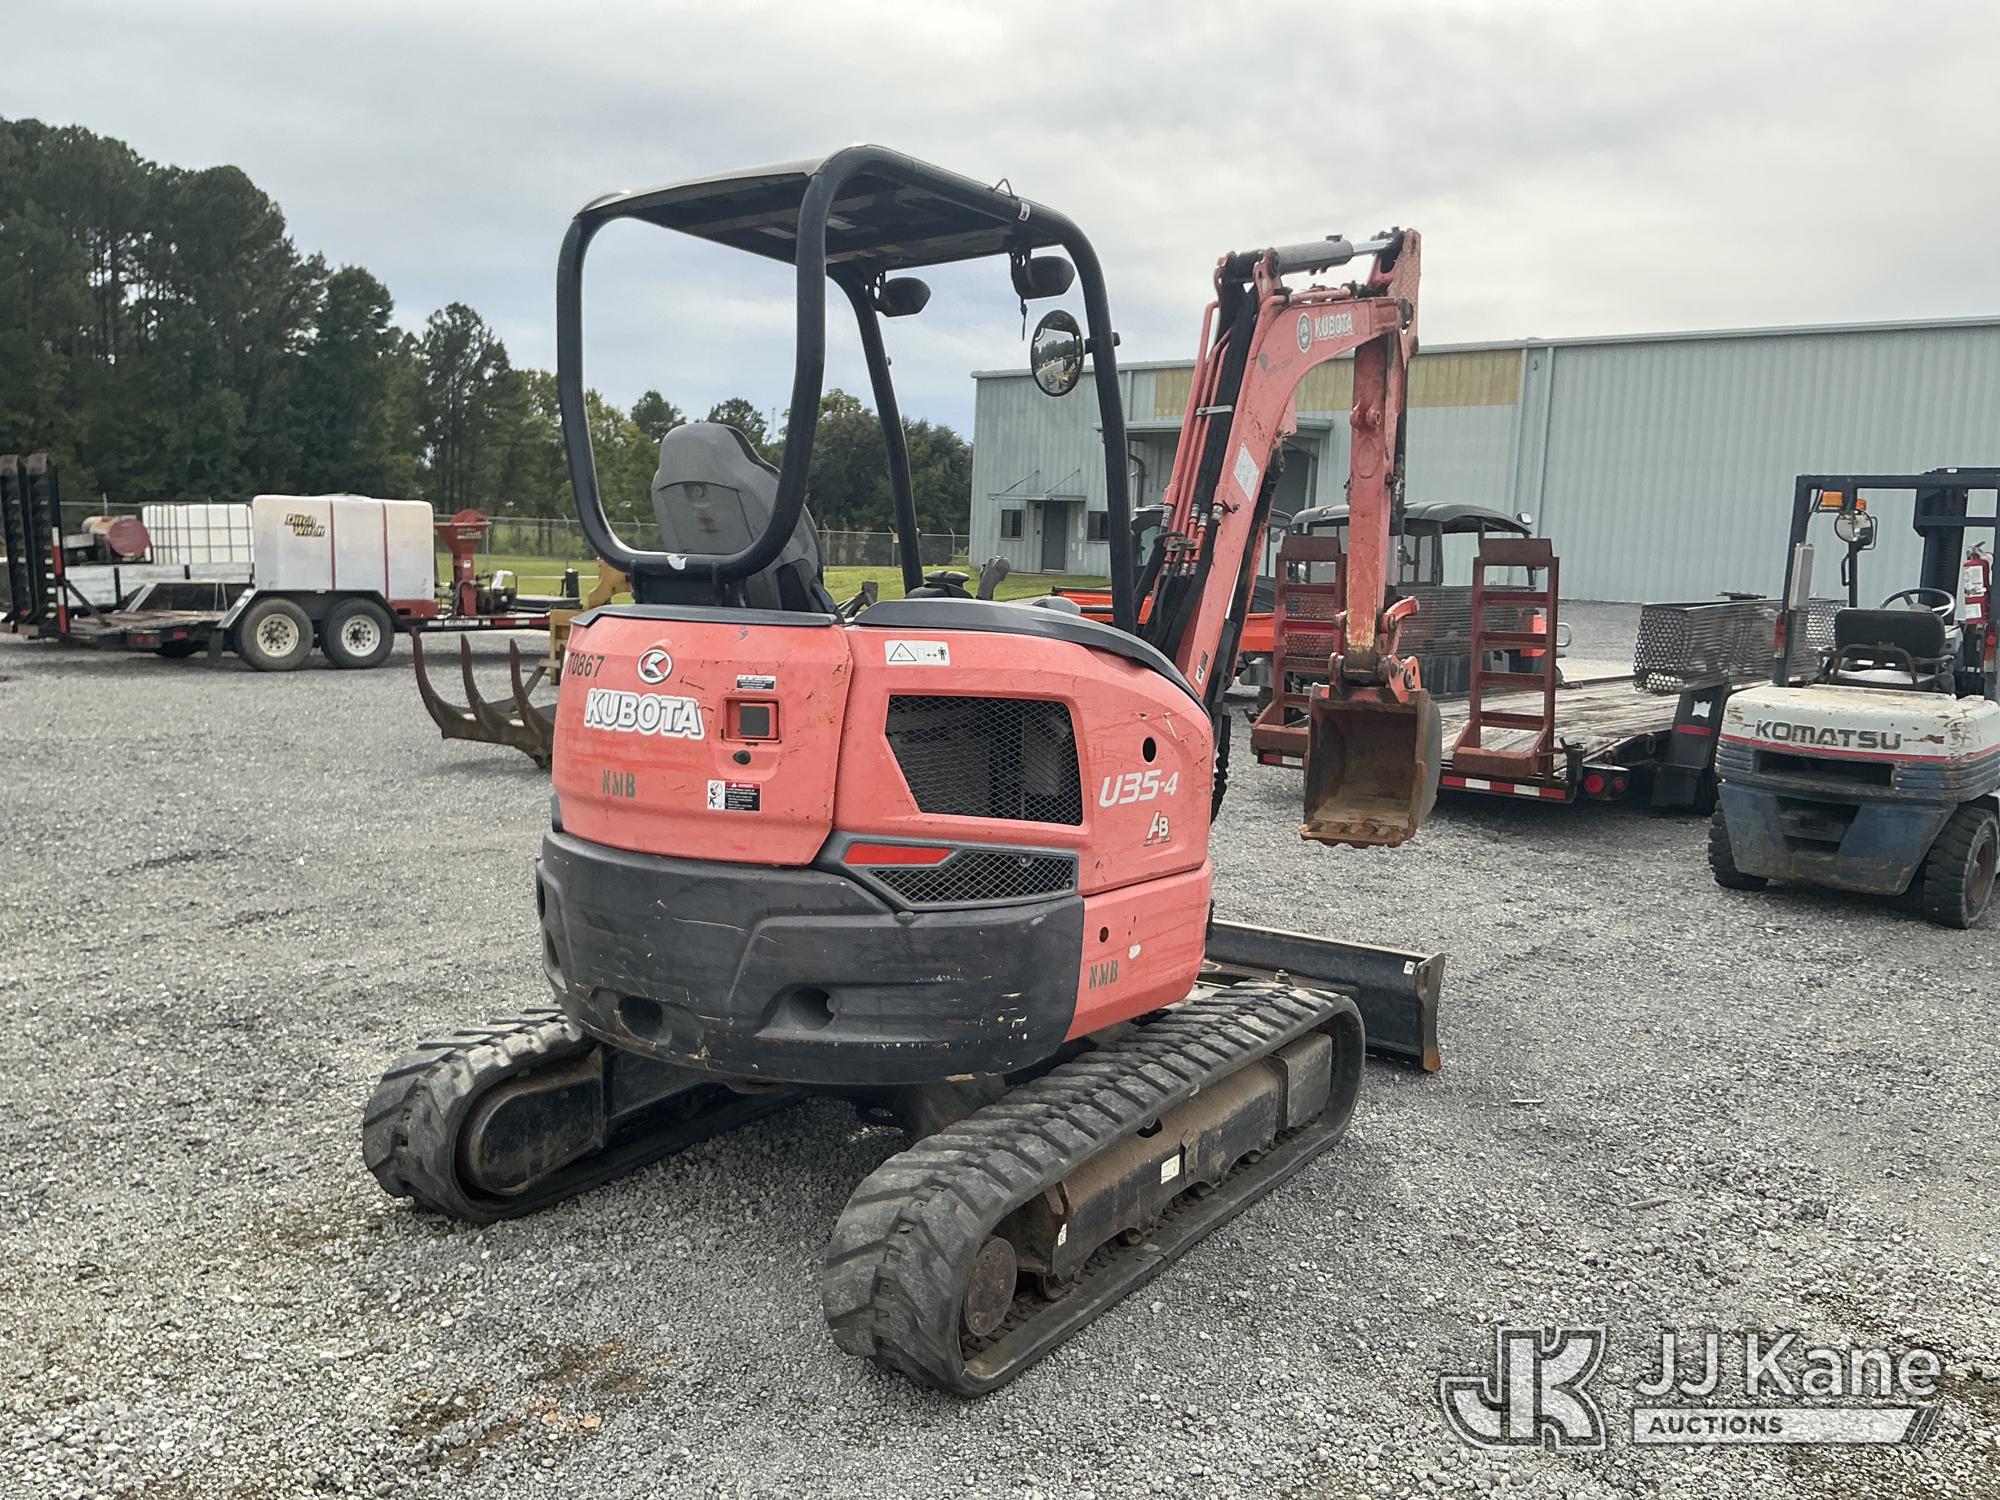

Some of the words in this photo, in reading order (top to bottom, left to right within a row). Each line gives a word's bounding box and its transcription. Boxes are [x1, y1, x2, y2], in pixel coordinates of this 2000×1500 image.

[1314, 312, 1353, 339] KUBOTA
[585, 689, 703, 737] KUBOTA
[1755, 719, 1902, 751] KOMATSU
[602, 769, 636, 798] NMB
[1098, 769, 1180, 808] U35-4
[1088, 959, 1119, 989] NMB
